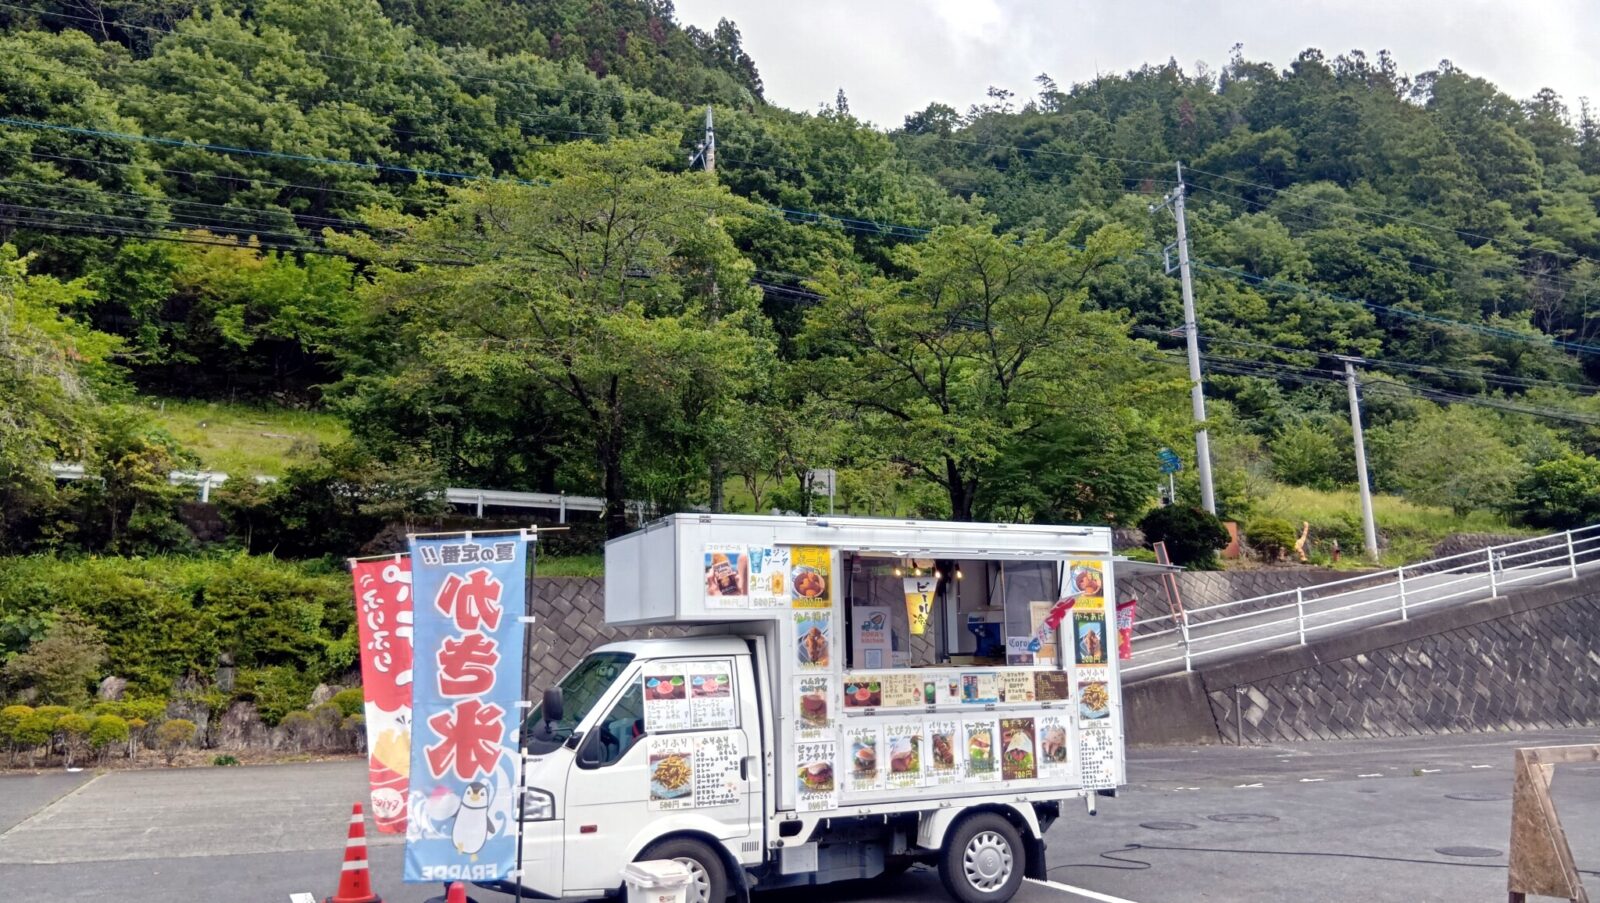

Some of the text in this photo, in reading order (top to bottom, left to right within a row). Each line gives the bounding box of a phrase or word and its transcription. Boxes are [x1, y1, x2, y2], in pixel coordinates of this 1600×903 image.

[763, 557, 789, 566] ソーダ
[917, 581, 930, 615] ビール
[1009, 639, 1028, 649] Coro
[887, 724, 921, 736] えびカツ
[651, 739, 688, 749] ふりふり
